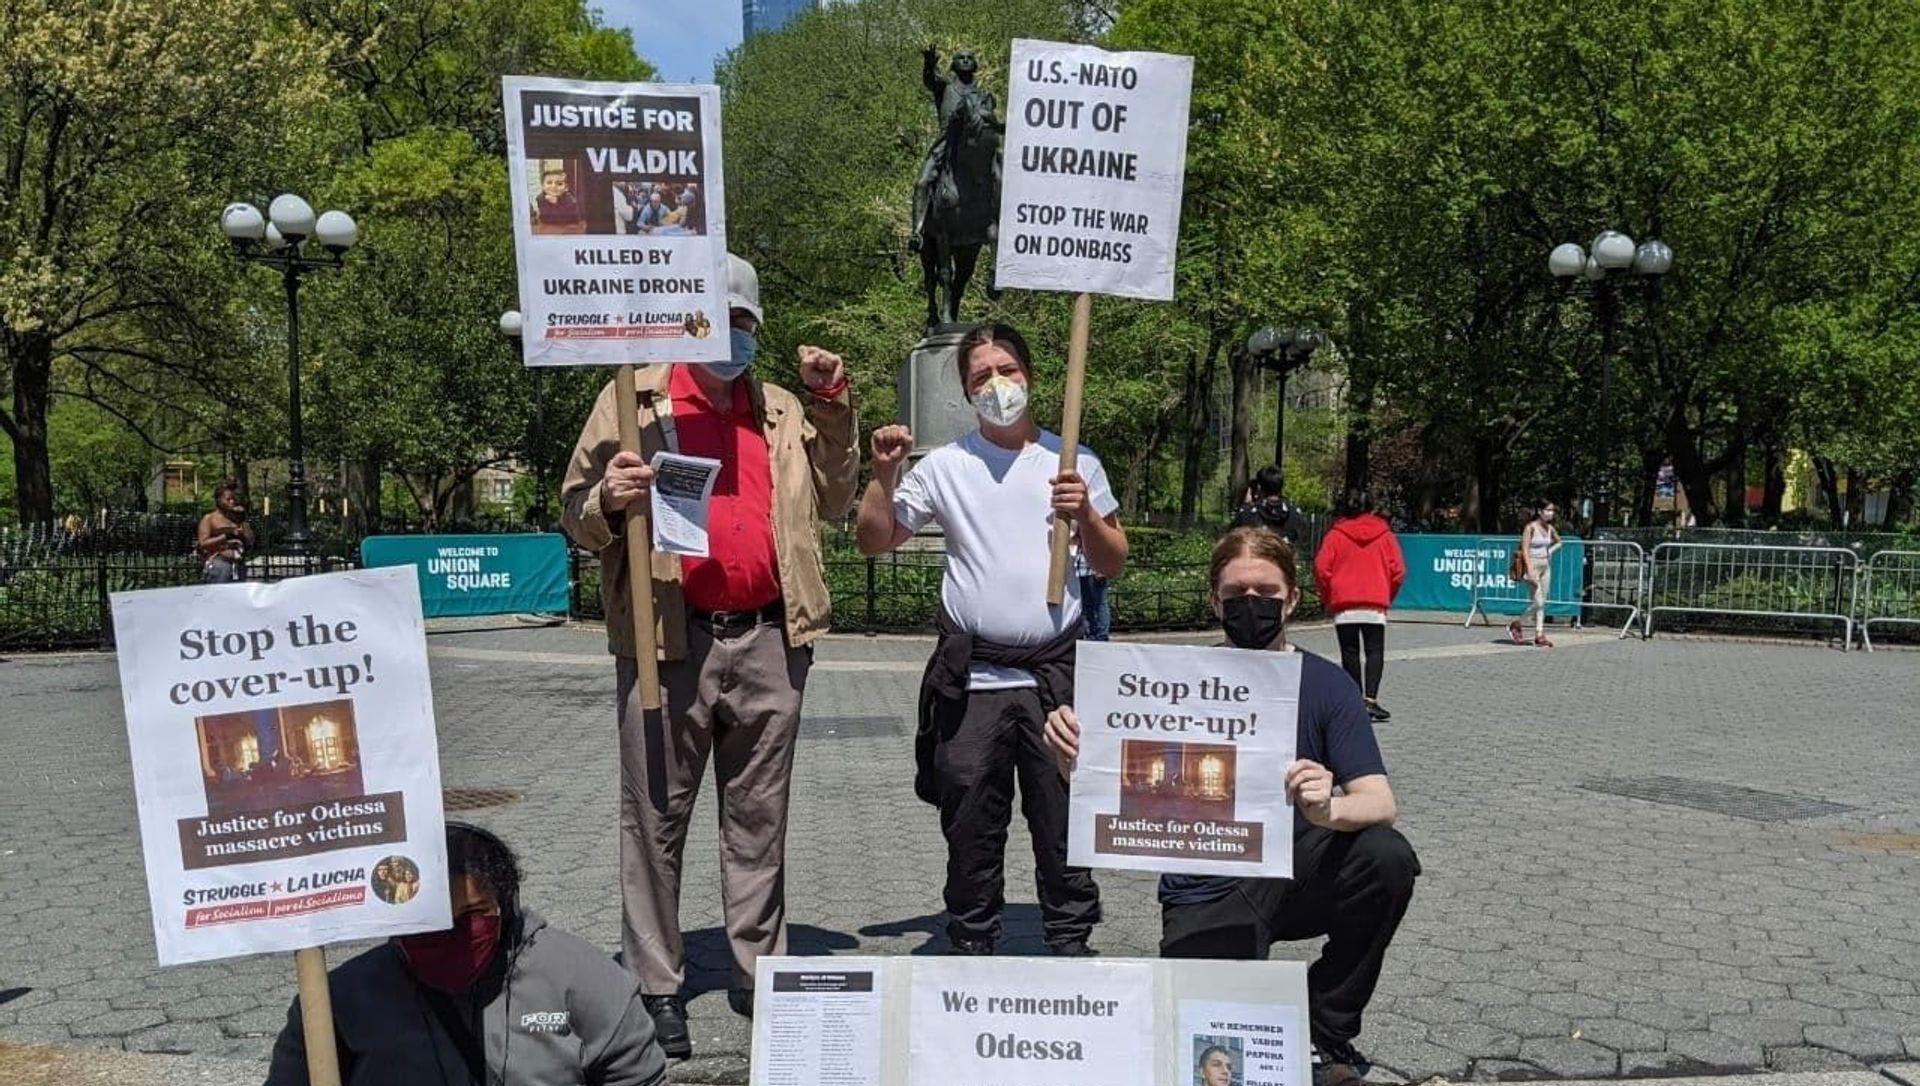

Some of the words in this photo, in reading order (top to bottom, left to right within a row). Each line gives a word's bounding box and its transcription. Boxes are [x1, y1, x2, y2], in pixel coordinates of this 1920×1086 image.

[1027, 59, 1137, 90] U.S.-NATO
[530, 104, 637, 129] JUSTICE
[643, 109, 694, 132] FOR
[1024, 98, 1084, 129] OUT
[1092, 102, 1128, 133] OF
[587, 147, 698, 175] VLADIK
[1021, 145, 1138, 181] UKRAINE
[1016, 203, 1066, 226] STOP
[1071, 207, 1105, 229] THE
[1110, 211, 1149, 235] WAR
[575, 249, 644, 265] KILLED
[649, 249, 673, 265] BY
[1014, 234, 1042, 255] ON
[1046, 236, 1132, 263] DONBASS
[543, 279, 634, 295] UKRAINE
[639, 278, 705, 295] DRONE
[547, 312, 610, 326] STRUGGLE
[628, 312, 642, 324] LA
[645, 310, 683, 325] LUCHA
[427, 558, 480, 574] UNION
[437, 547, 485, 557] WELCOME
[486, 547, 499, 556] TO
[1433, 558, 1485, 573] UNION
[1492, 549, 1506, 559] TO
[446, 573, 511, 592] SQUARE
[179, 626, 276, 662] Stop
[285, 615, 358, 647] the
[169, 654, 376, 706] cover-up!
[1117, 673, 1190, 705] Stop
[1198, 676, 1250, 702] the
[1106, 710, 1257, 740] cover-up!
[196, 814, 270, 839] Justice
[273, 808, 306, 830] for
[311, 799, 387, 822] Odessa
[1108, 817, 1163, 833] Justice
[1167, 820, 1190, 834] for
[1193, 822, 1249, 838] Odessa
[205, 832, 302, 858] massacre
[306, 820, 383, 844] victims
[1112, 835, 1185, 850] massacre
[1188, 838, 1246, 854] victims
[183, 882, 267, 906] STRUGGLE
[287, 876, 309, 893] LA
[312, 867, 366, 890] LUCHA
[303, 892, 364, 910] Socialismo
[942, 990, 978, 1013] We
[987, 994, 1119, 1017] remember
[1210, 1022, 1225, 1030] WE
[1227, 1023, 1284, 1033] REMEMBER
[975, 1032, 1084, 1061] Odessa
[1251, 1037, 1284, 1047] VADIM
